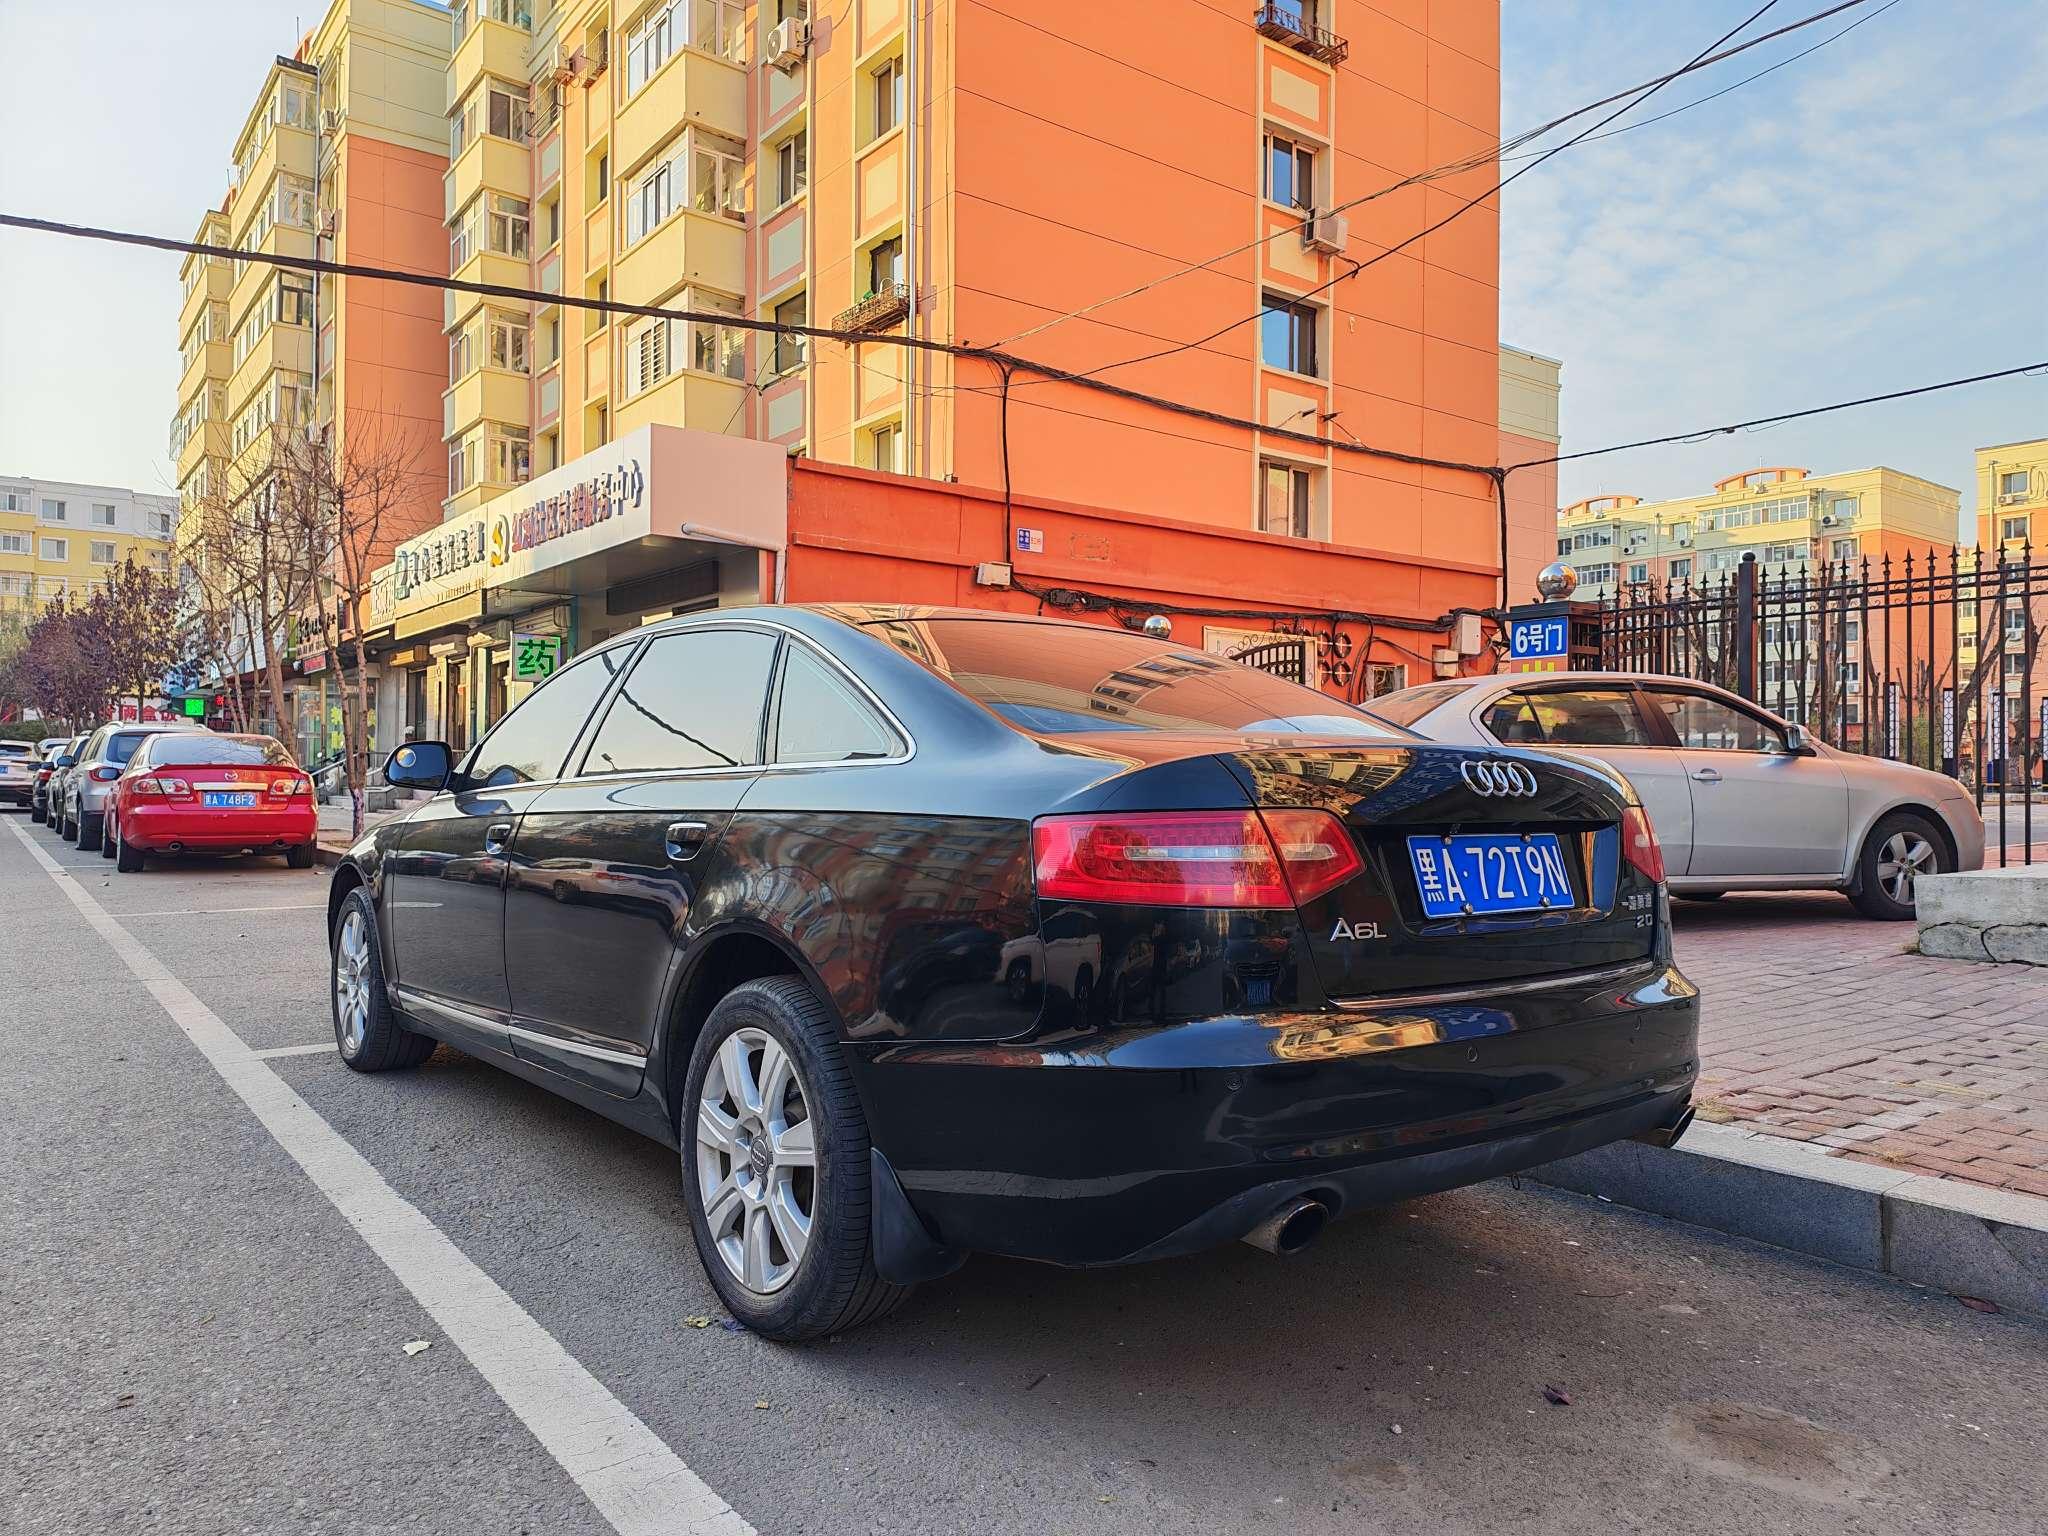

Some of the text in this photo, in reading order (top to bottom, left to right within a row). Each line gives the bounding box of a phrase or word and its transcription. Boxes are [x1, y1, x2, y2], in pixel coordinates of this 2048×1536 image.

[1515, 624, 1562, 653] 6号门
[517, 638, 556, 678] 药
[1329, 917, 1387, 941] A6L
